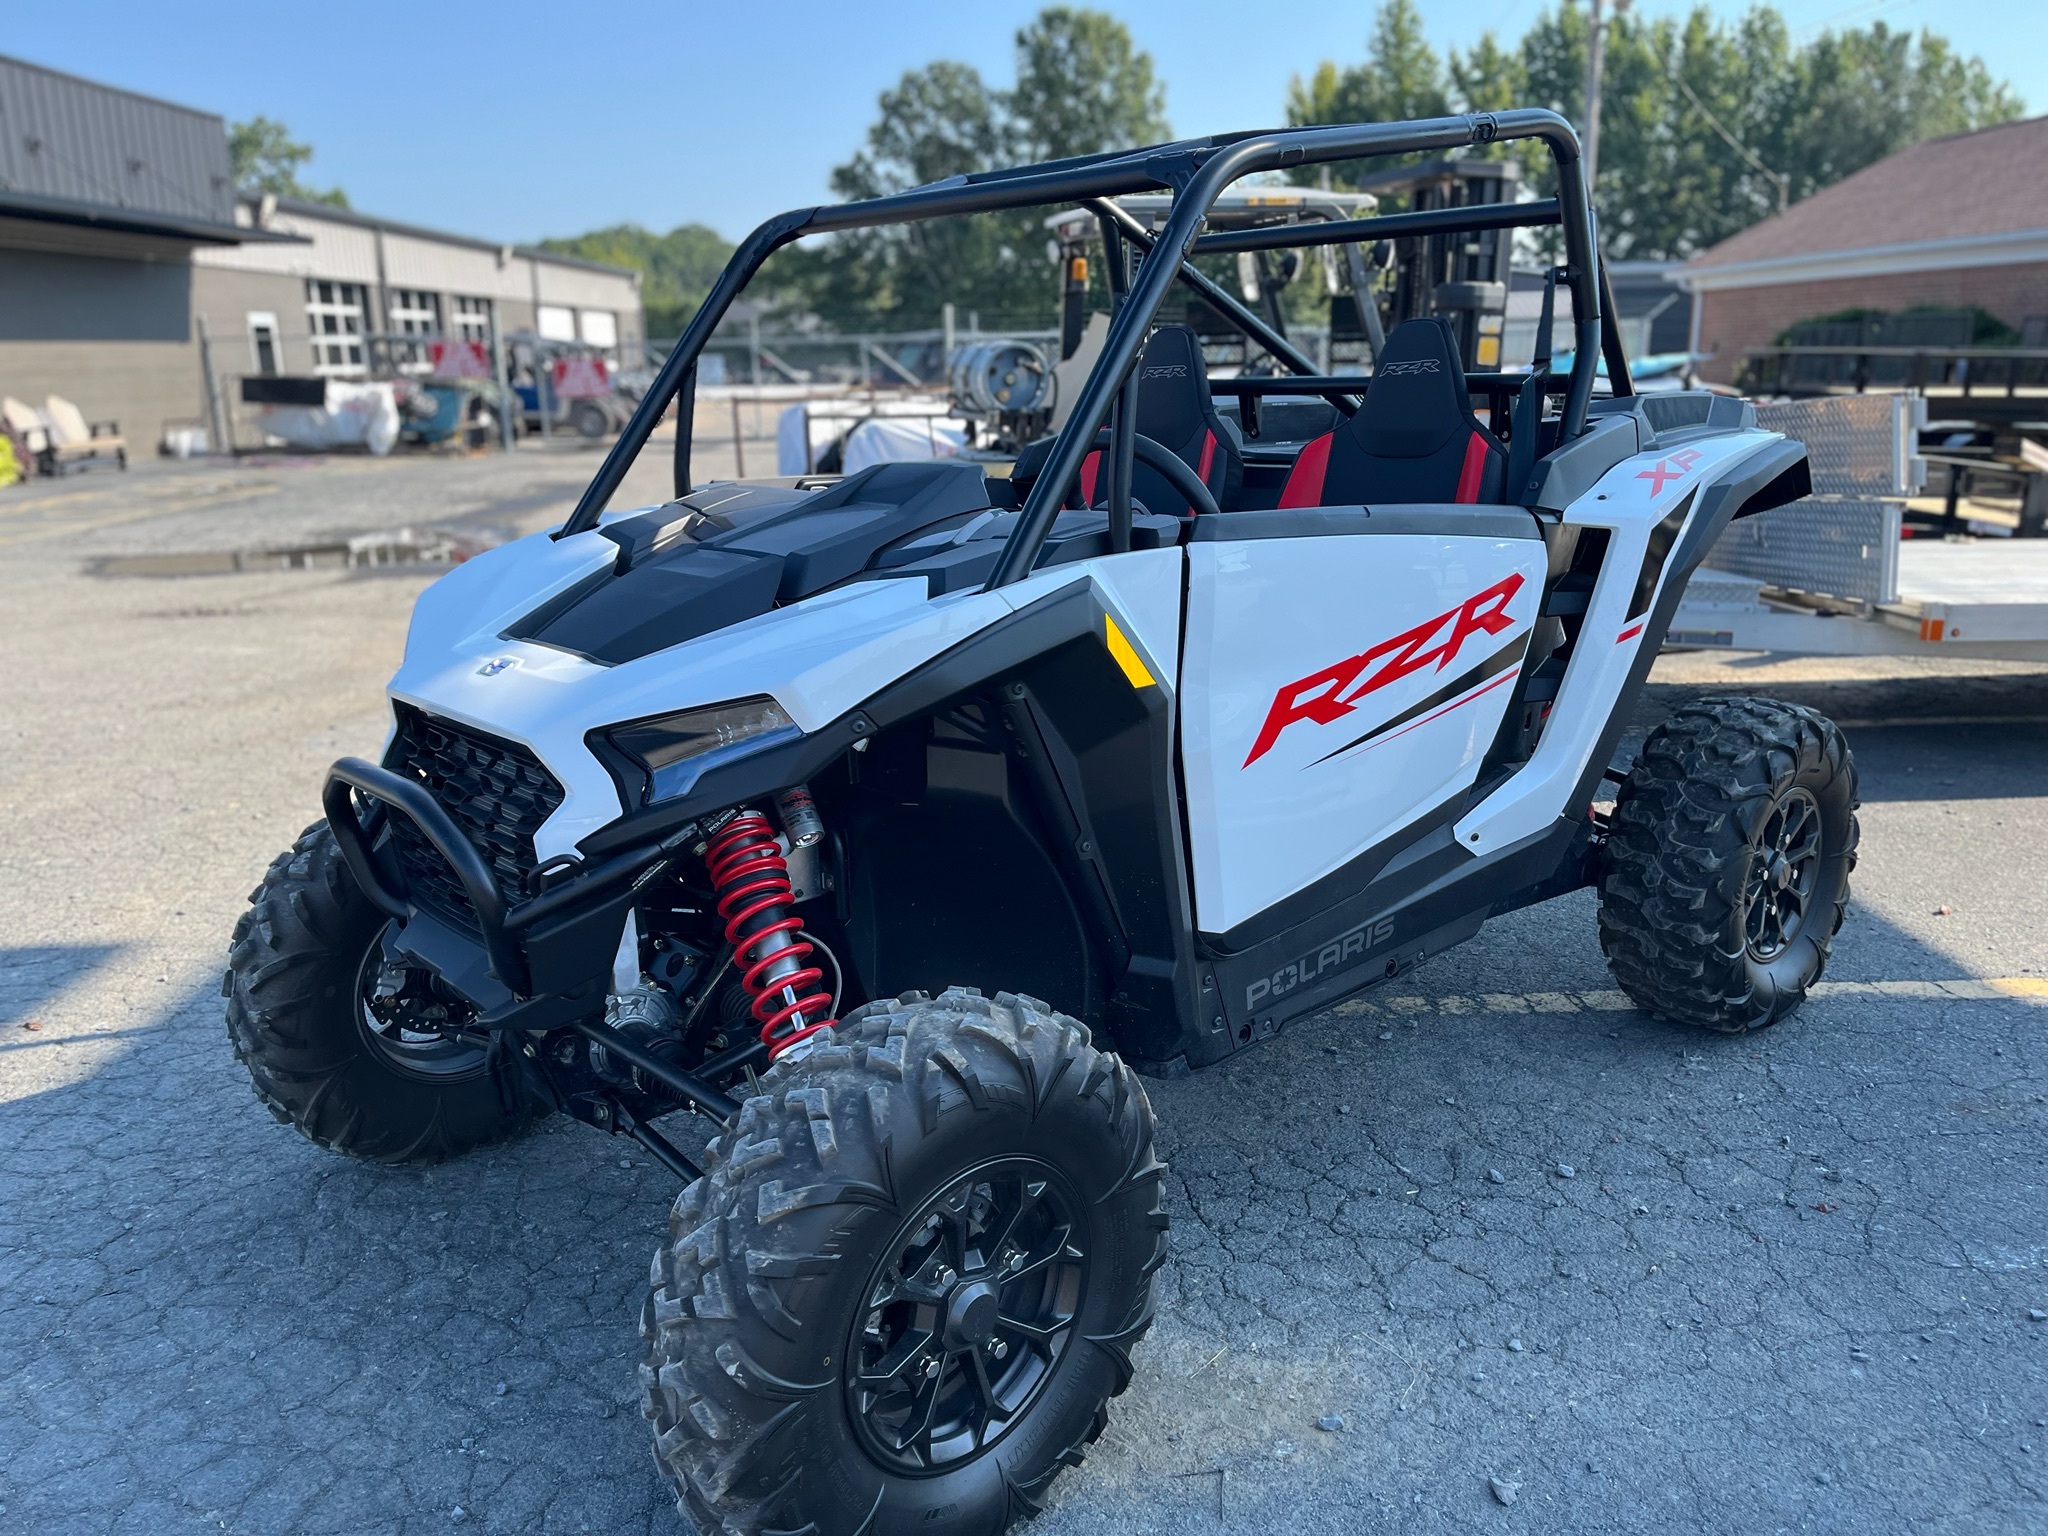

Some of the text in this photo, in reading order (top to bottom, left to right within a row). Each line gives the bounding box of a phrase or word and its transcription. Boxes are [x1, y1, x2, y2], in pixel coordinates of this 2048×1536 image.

[1141, 364, 1187, 380] RZR
[1379, 358, 1440, 377] RZR
[1634, 448, 1704, 500] XP
[1240, 572, 1526, 771] RZR
[708, 808, 737, 833] POLARIS
[1246, 916, 1395, 1011] POLARIS
